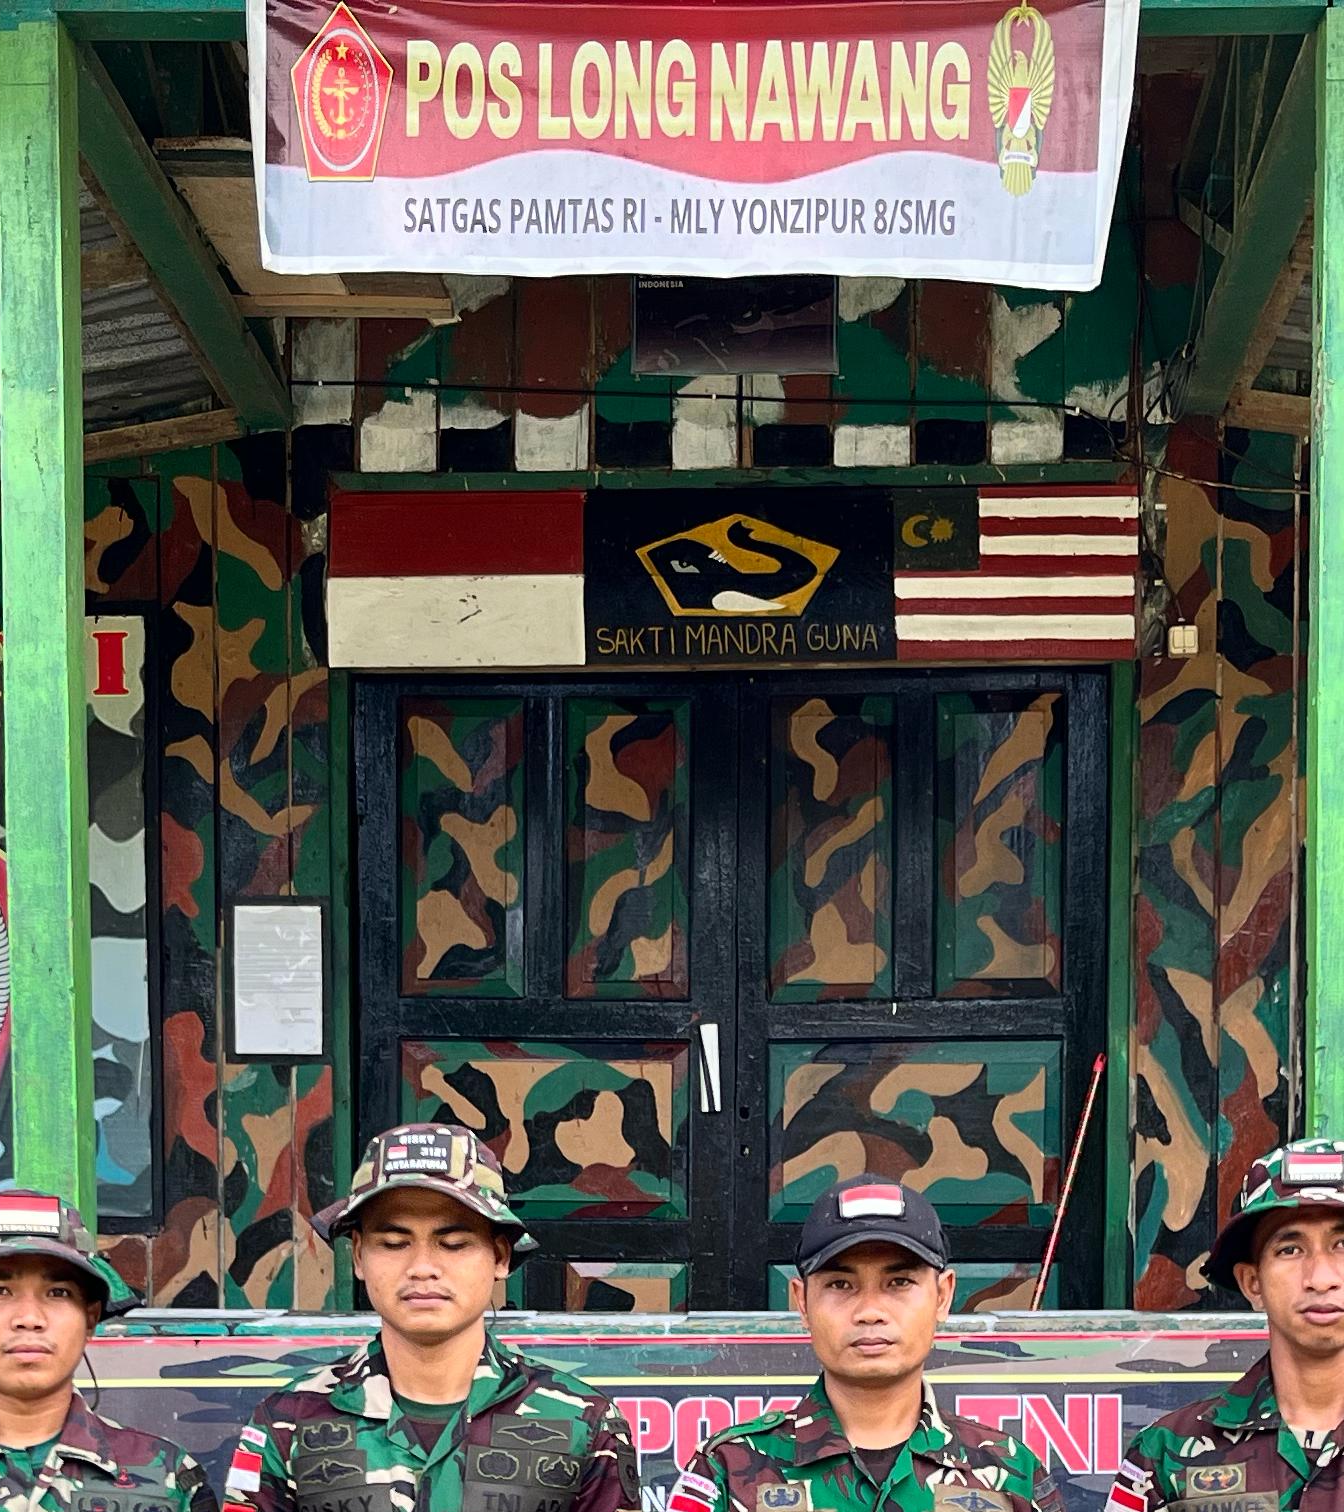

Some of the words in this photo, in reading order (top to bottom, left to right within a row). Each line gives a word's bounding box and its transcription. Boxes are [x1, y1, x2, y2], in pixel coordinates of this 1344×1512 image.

[405, 39, 524, 140] POS
[537, 38, 698, 140] LONG
[709, 39, 972, 142] NAWANG
[403, 197, 502, 234] SATGAS
[509, 198, 615, 235] PAMTAS
[622, 198, 647, 234] RI
[669, 198, 726, 235] MLY
[731, 198, 867, 236] YONZIPUR
[872, 199, 957, 236] 8/SMG
[595, 625, 677, 656] SAKTI
[685, 623, 798, 656] MANDRA
